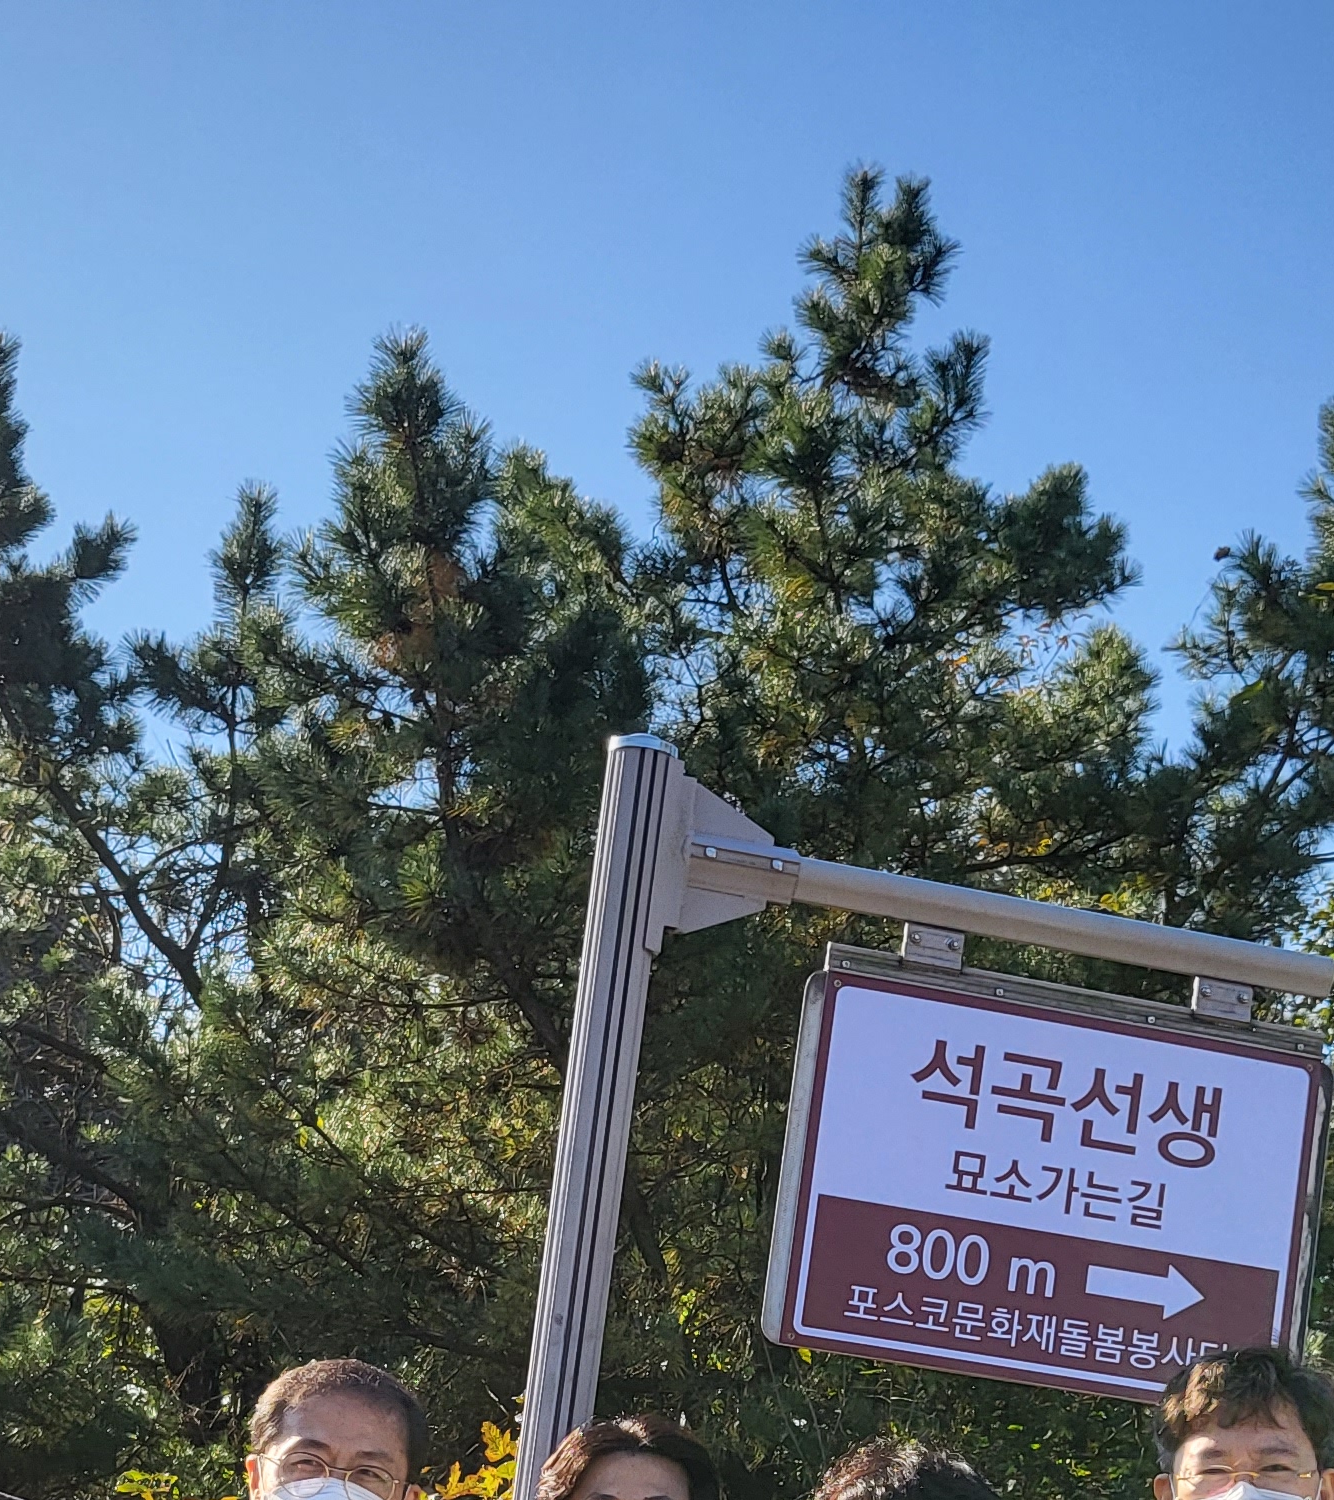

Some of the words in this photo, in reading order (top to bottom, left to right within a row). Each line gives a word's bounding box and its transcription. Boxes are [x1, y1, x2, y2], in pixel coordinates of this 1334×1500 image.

[910, 1038, 1223, 1169] 석곡선생
[944, 1149, 1167, 1230] 묘소가는길
[885, 1223, 990, 1287] 800
[1006, 1255, 1057, 1298] m
